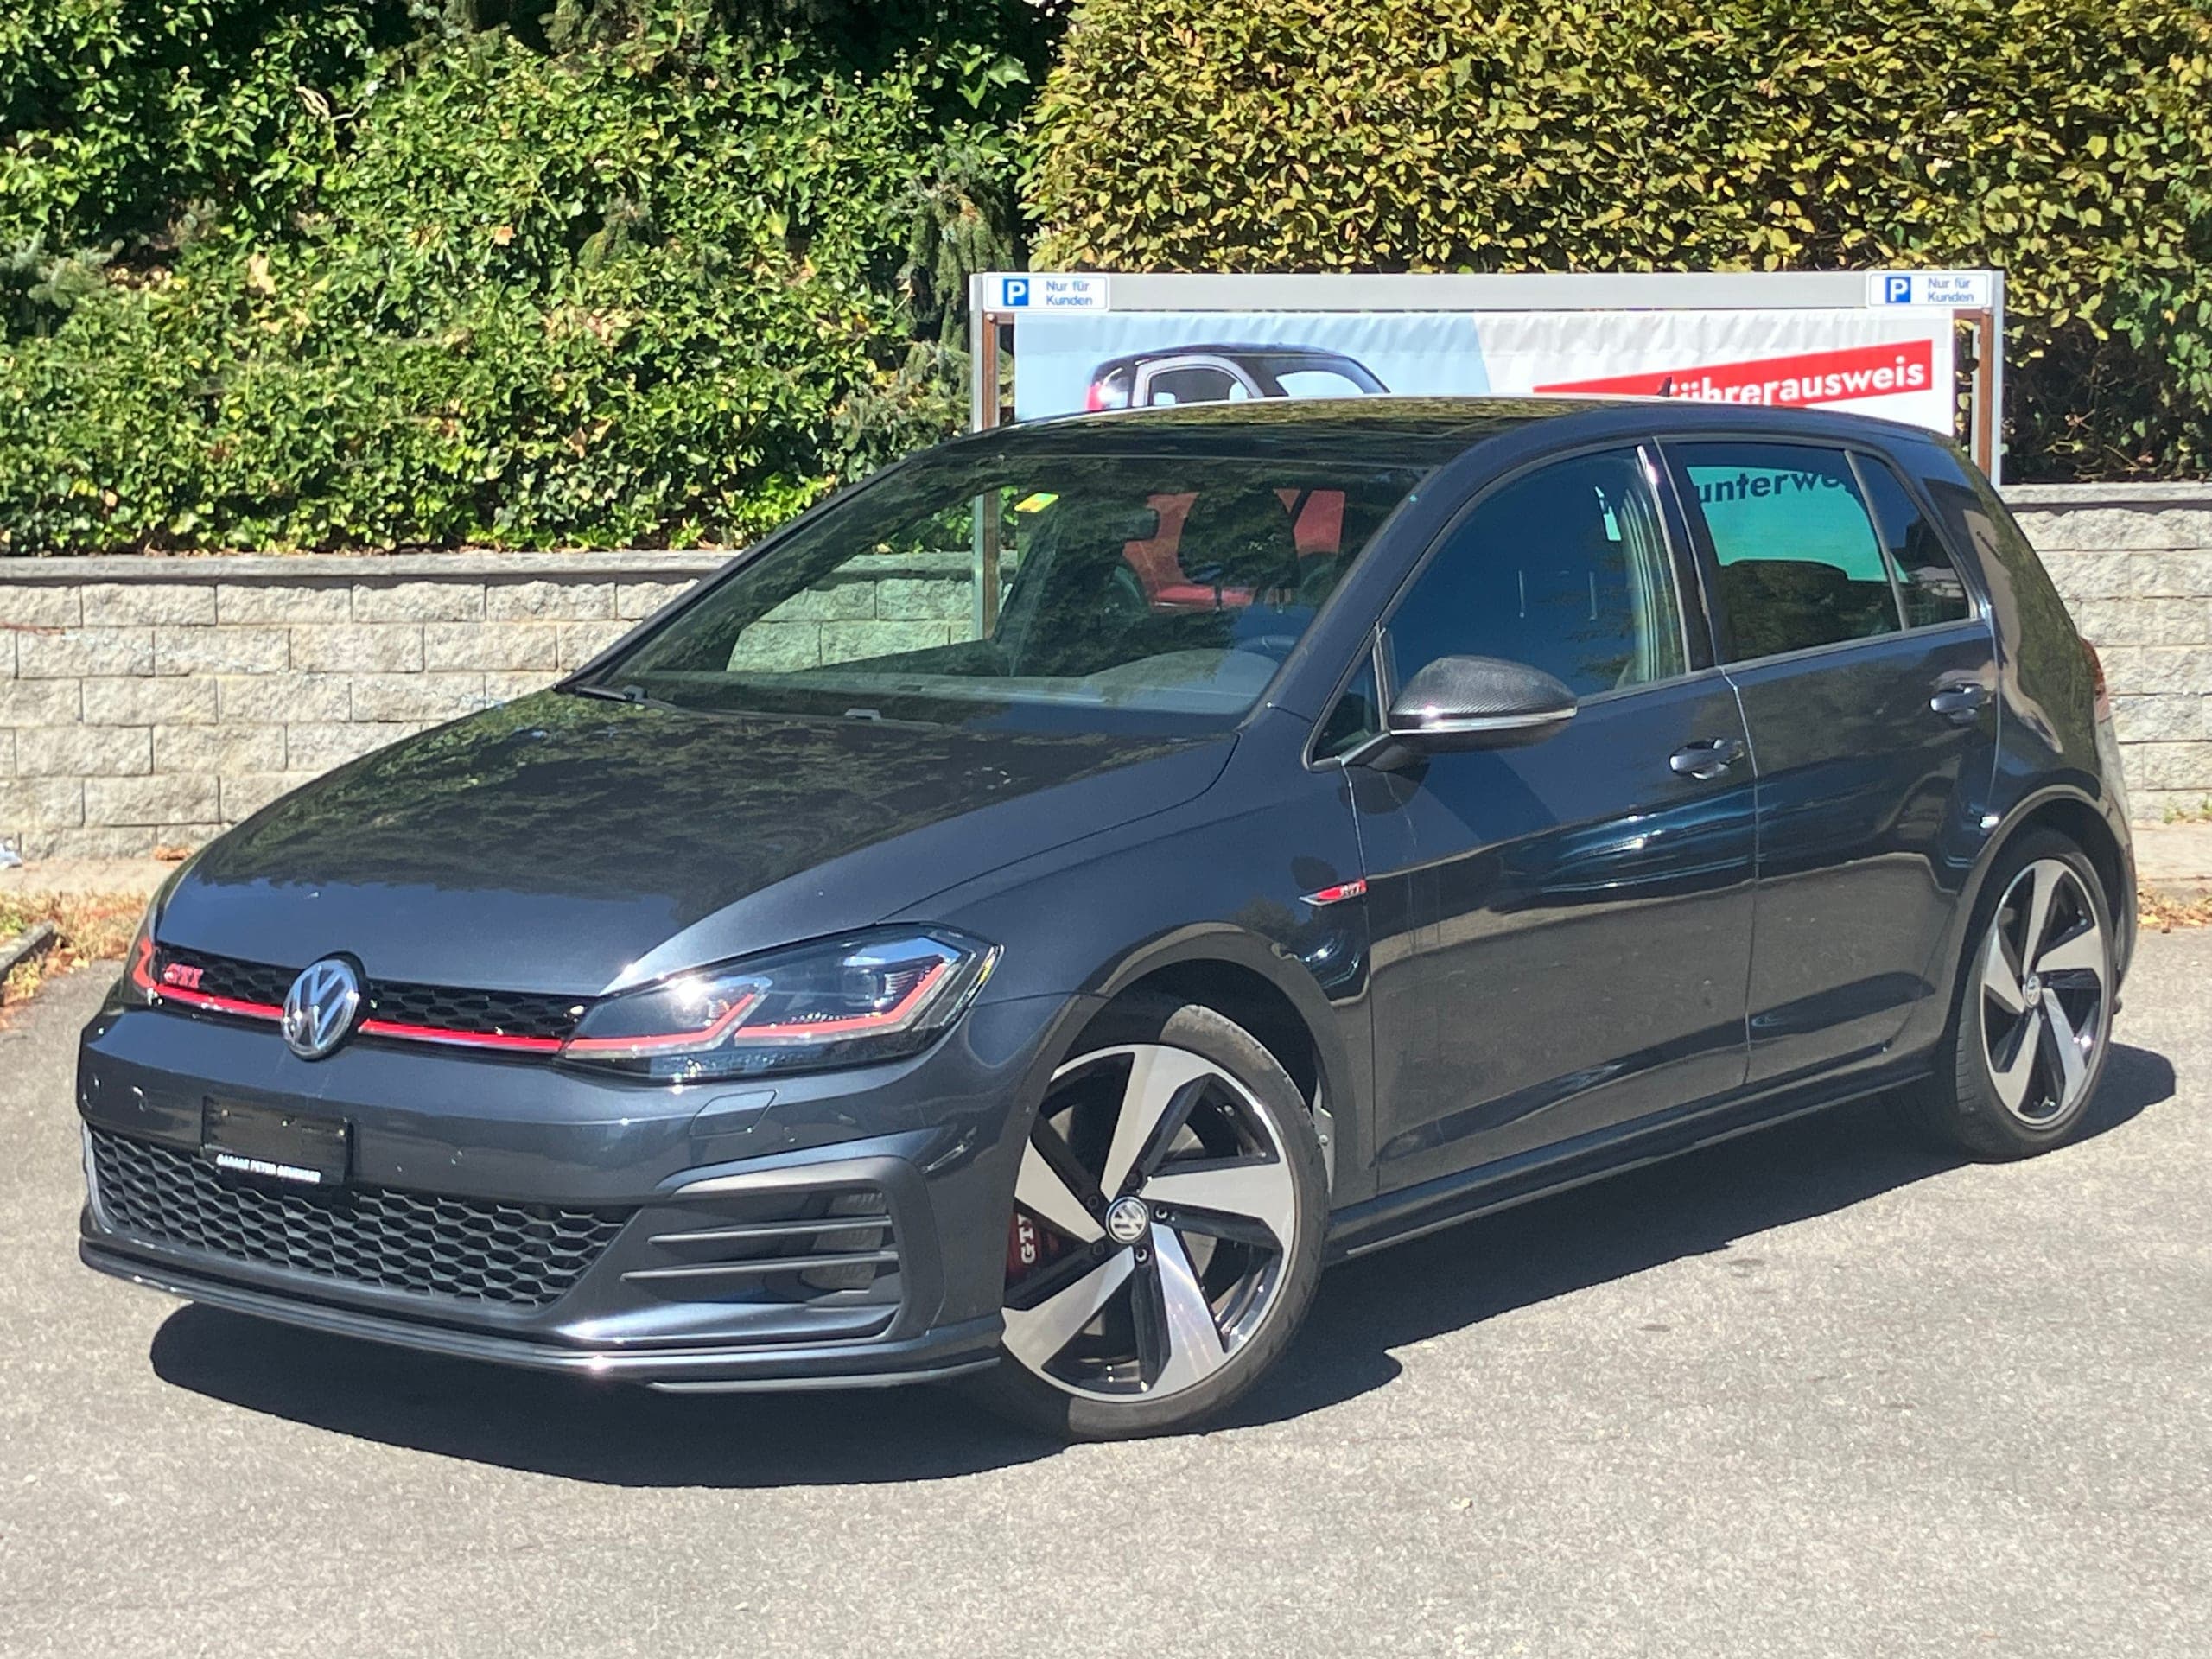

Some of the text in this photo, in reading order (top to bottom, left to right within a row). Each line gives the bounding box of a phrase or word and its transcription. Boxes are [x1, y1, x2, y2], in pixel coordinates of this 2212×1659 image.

[1046, 279, 1090, 292] Nur für
[1889, 278, 1909, 302] P
[1927, 276, 1971, 289] Nur für
[1007, 281, 1027, 305] P
[1046, 294, 1094, 306] Kunden
[1927, 291, 1975, 302] Kunden
[1659, 355, 1924, 405] ührerausweis
[163, 963, 205, 989] GTI
